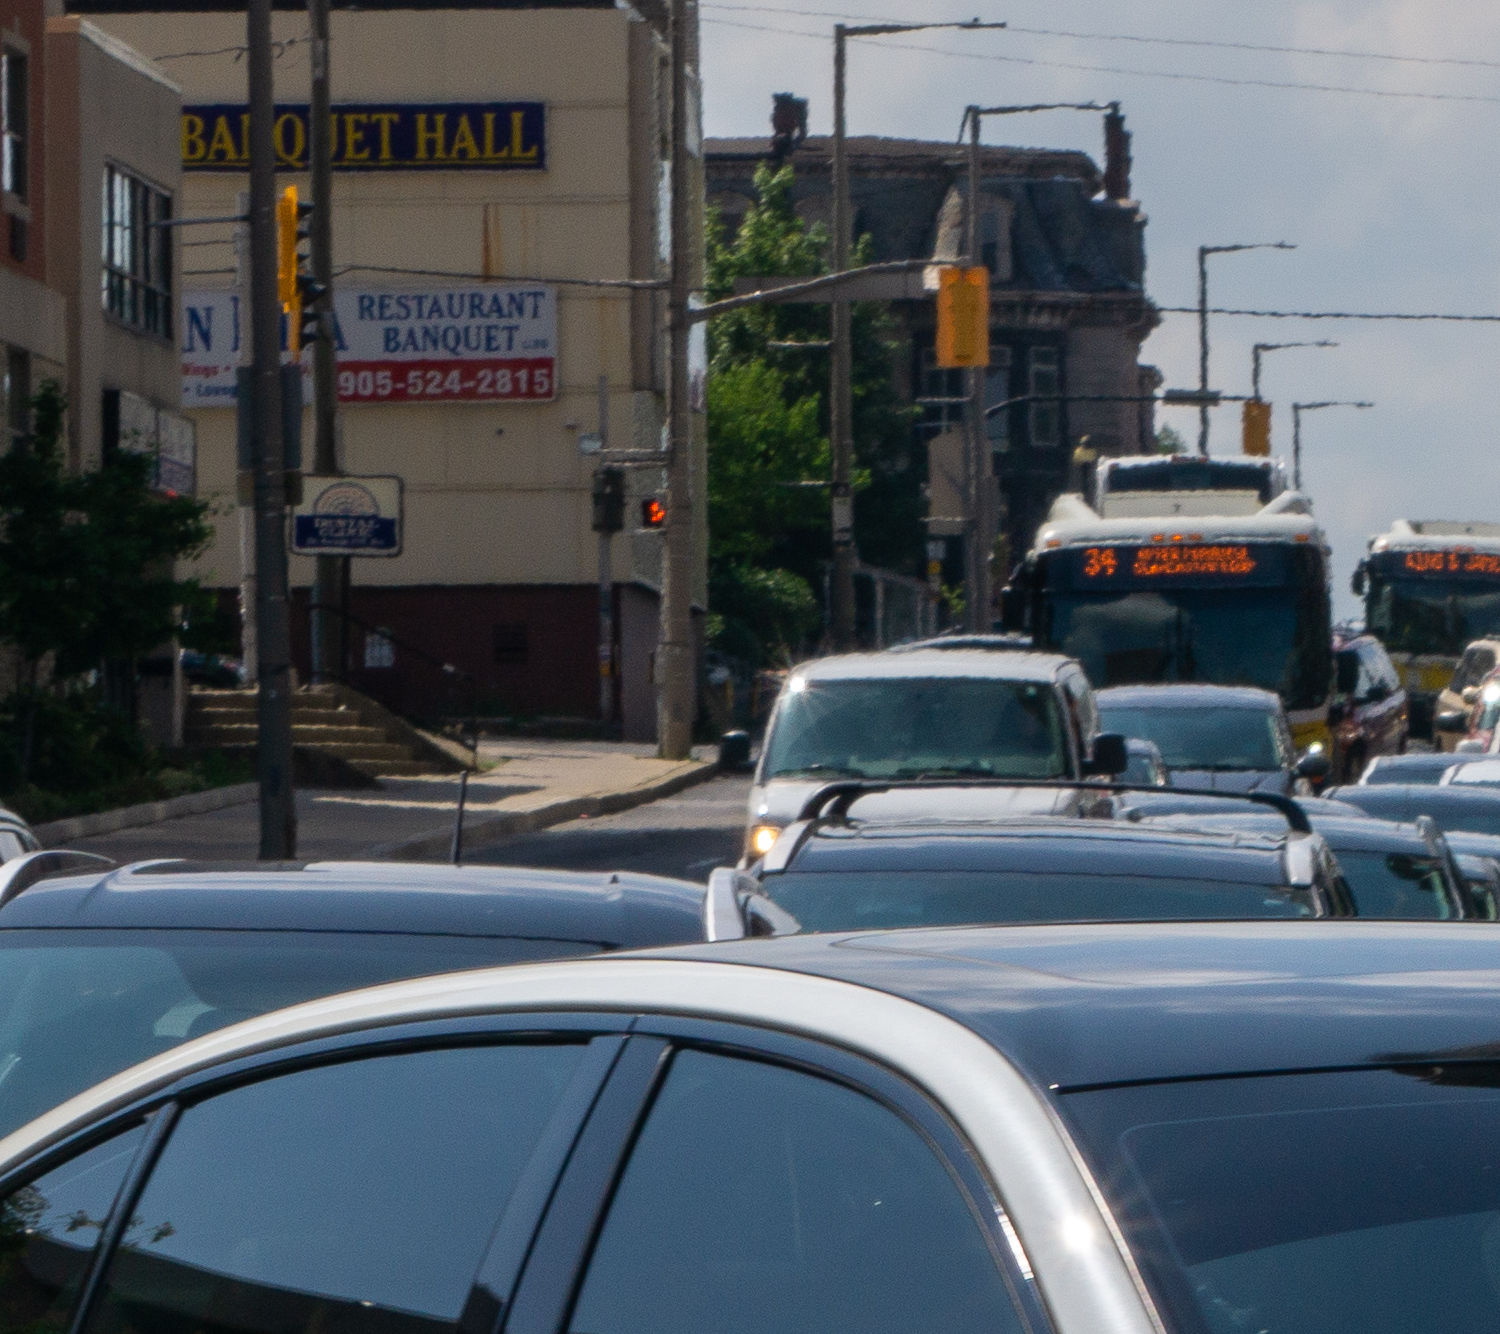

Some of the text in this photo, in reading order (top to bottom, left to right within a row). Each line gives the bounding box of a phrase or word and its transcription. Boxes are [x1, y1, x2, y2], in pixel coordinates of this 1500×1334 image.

[415, 111, 538, 160] HALL
[357, 291, 546, 321] RESTAURANT
[382, 324, 520, 356] BANQUET
[337, 368, 550, 397] 905-524-2815
[1084, 547, 1118, 577] 34
